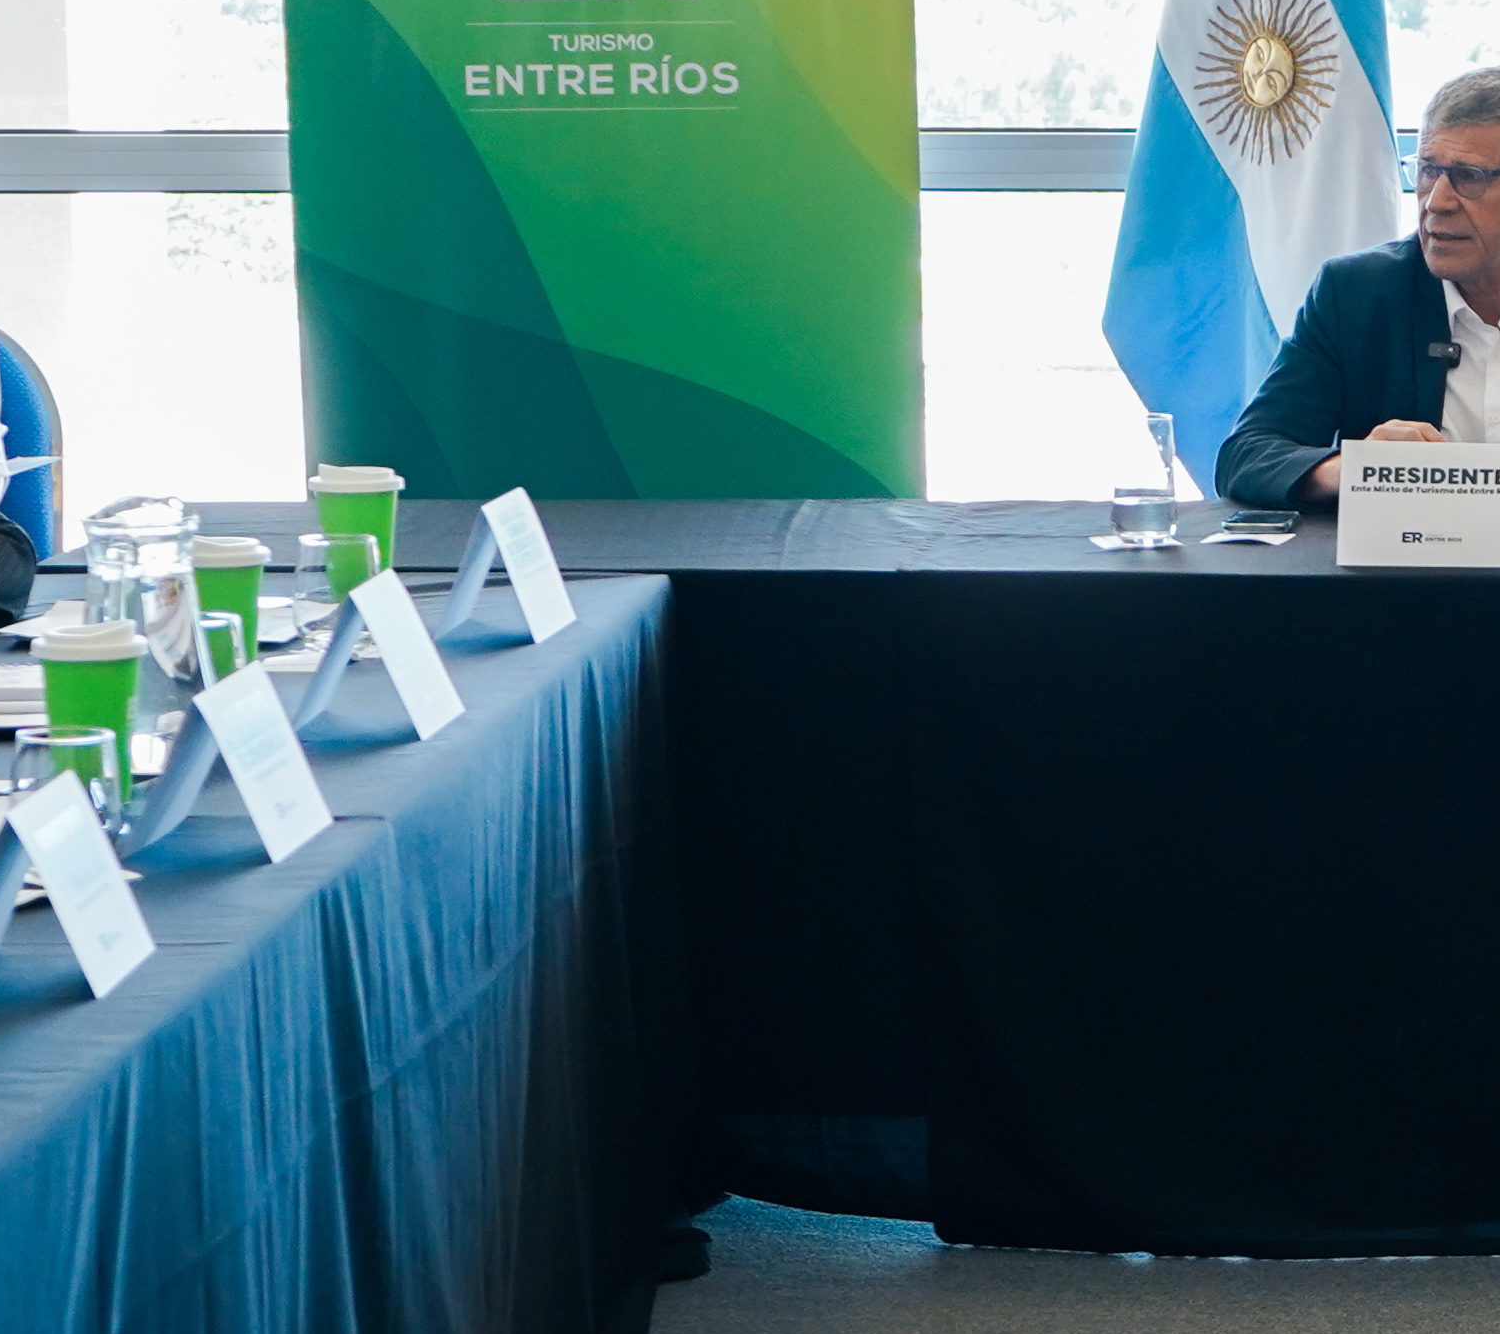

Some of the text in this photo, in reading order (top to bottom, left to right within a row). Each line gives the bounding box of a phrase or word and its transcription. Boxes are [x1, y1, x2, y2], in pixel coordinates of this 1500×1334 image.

[548, 34, 654, 52] TURISMO
[464, 54, 740, 96] ENTRE RÍOS
[1373, 484, 1400, 494] Mixto
[1402, 485, 1414, 494] de
[1416, 485, 1455, 495] Turismo
[1457, 486, 1469, 495] de
[1470, 486, 1495, 495] Entre
[1402, 531, 1423, 544] ER
